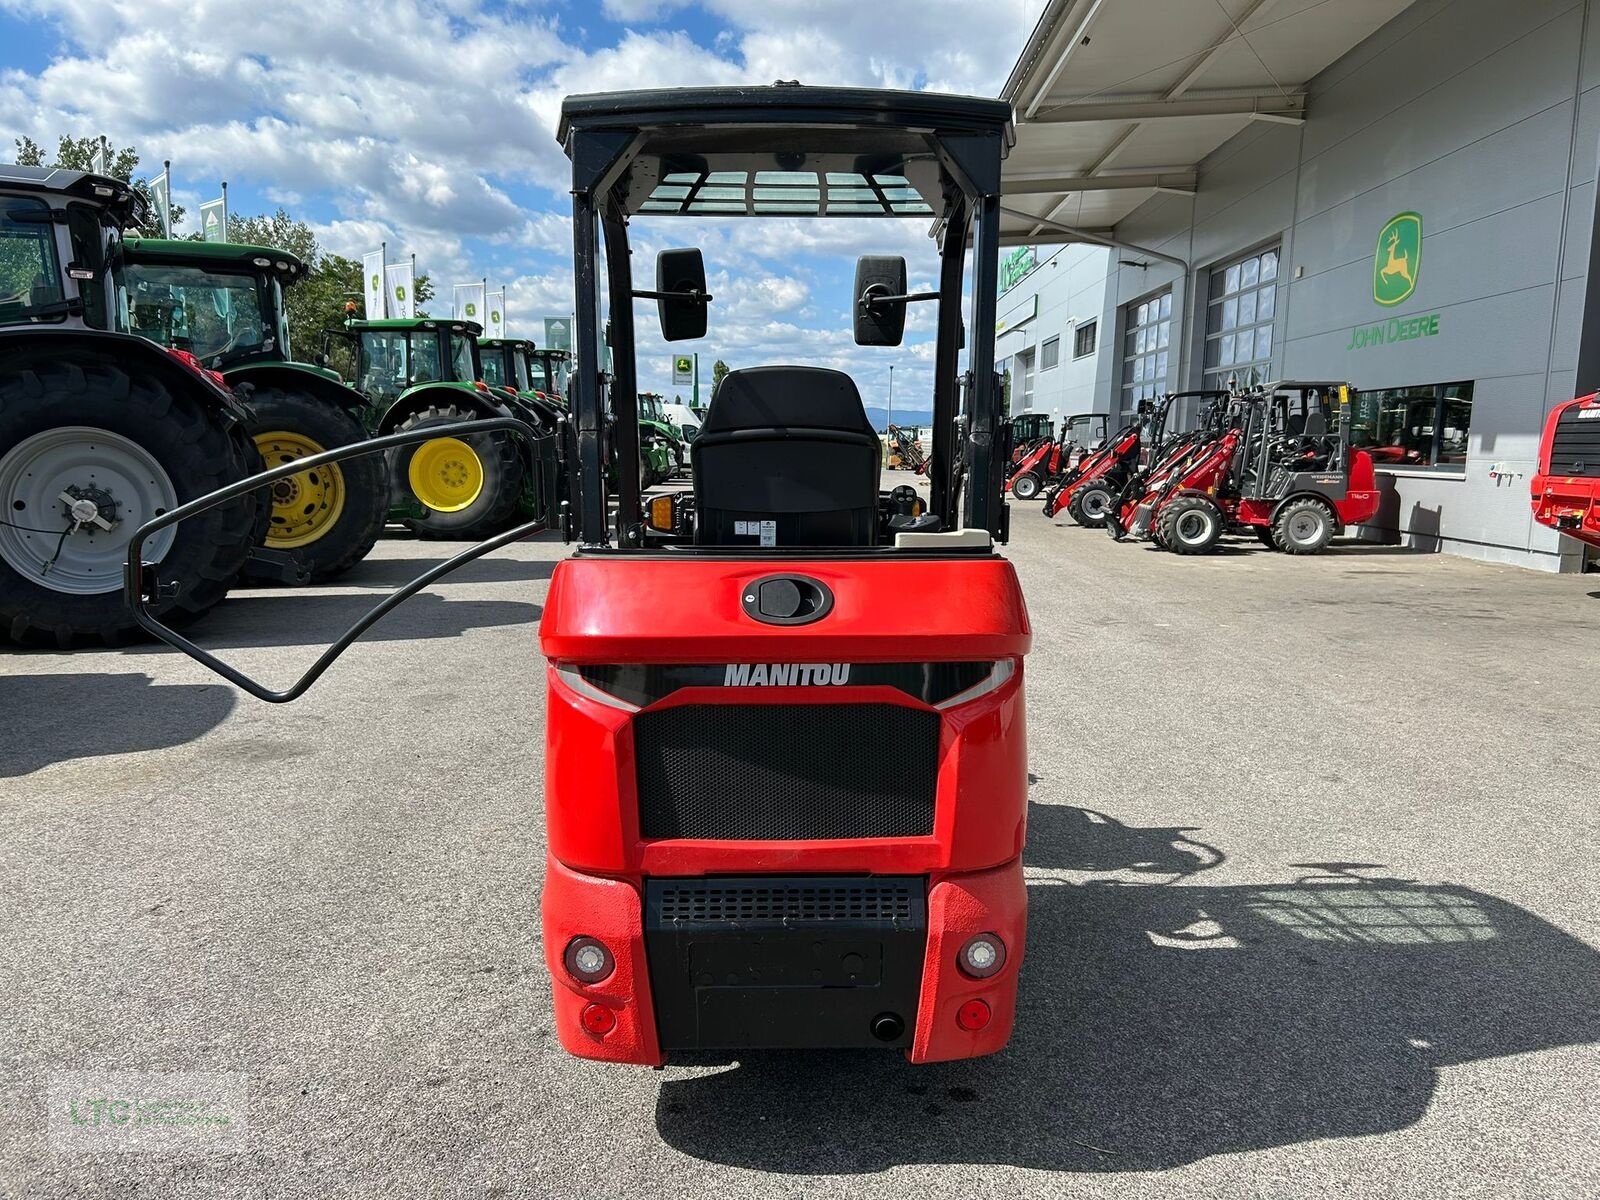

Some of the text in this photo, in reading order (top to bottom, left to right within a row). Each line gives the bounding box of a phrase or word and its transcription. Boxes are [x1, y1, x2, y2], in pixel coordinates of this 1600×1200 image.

[1346, 314, 1440, 351] JOHN DEERE
[723, 663, 851, 687] MANITOU
